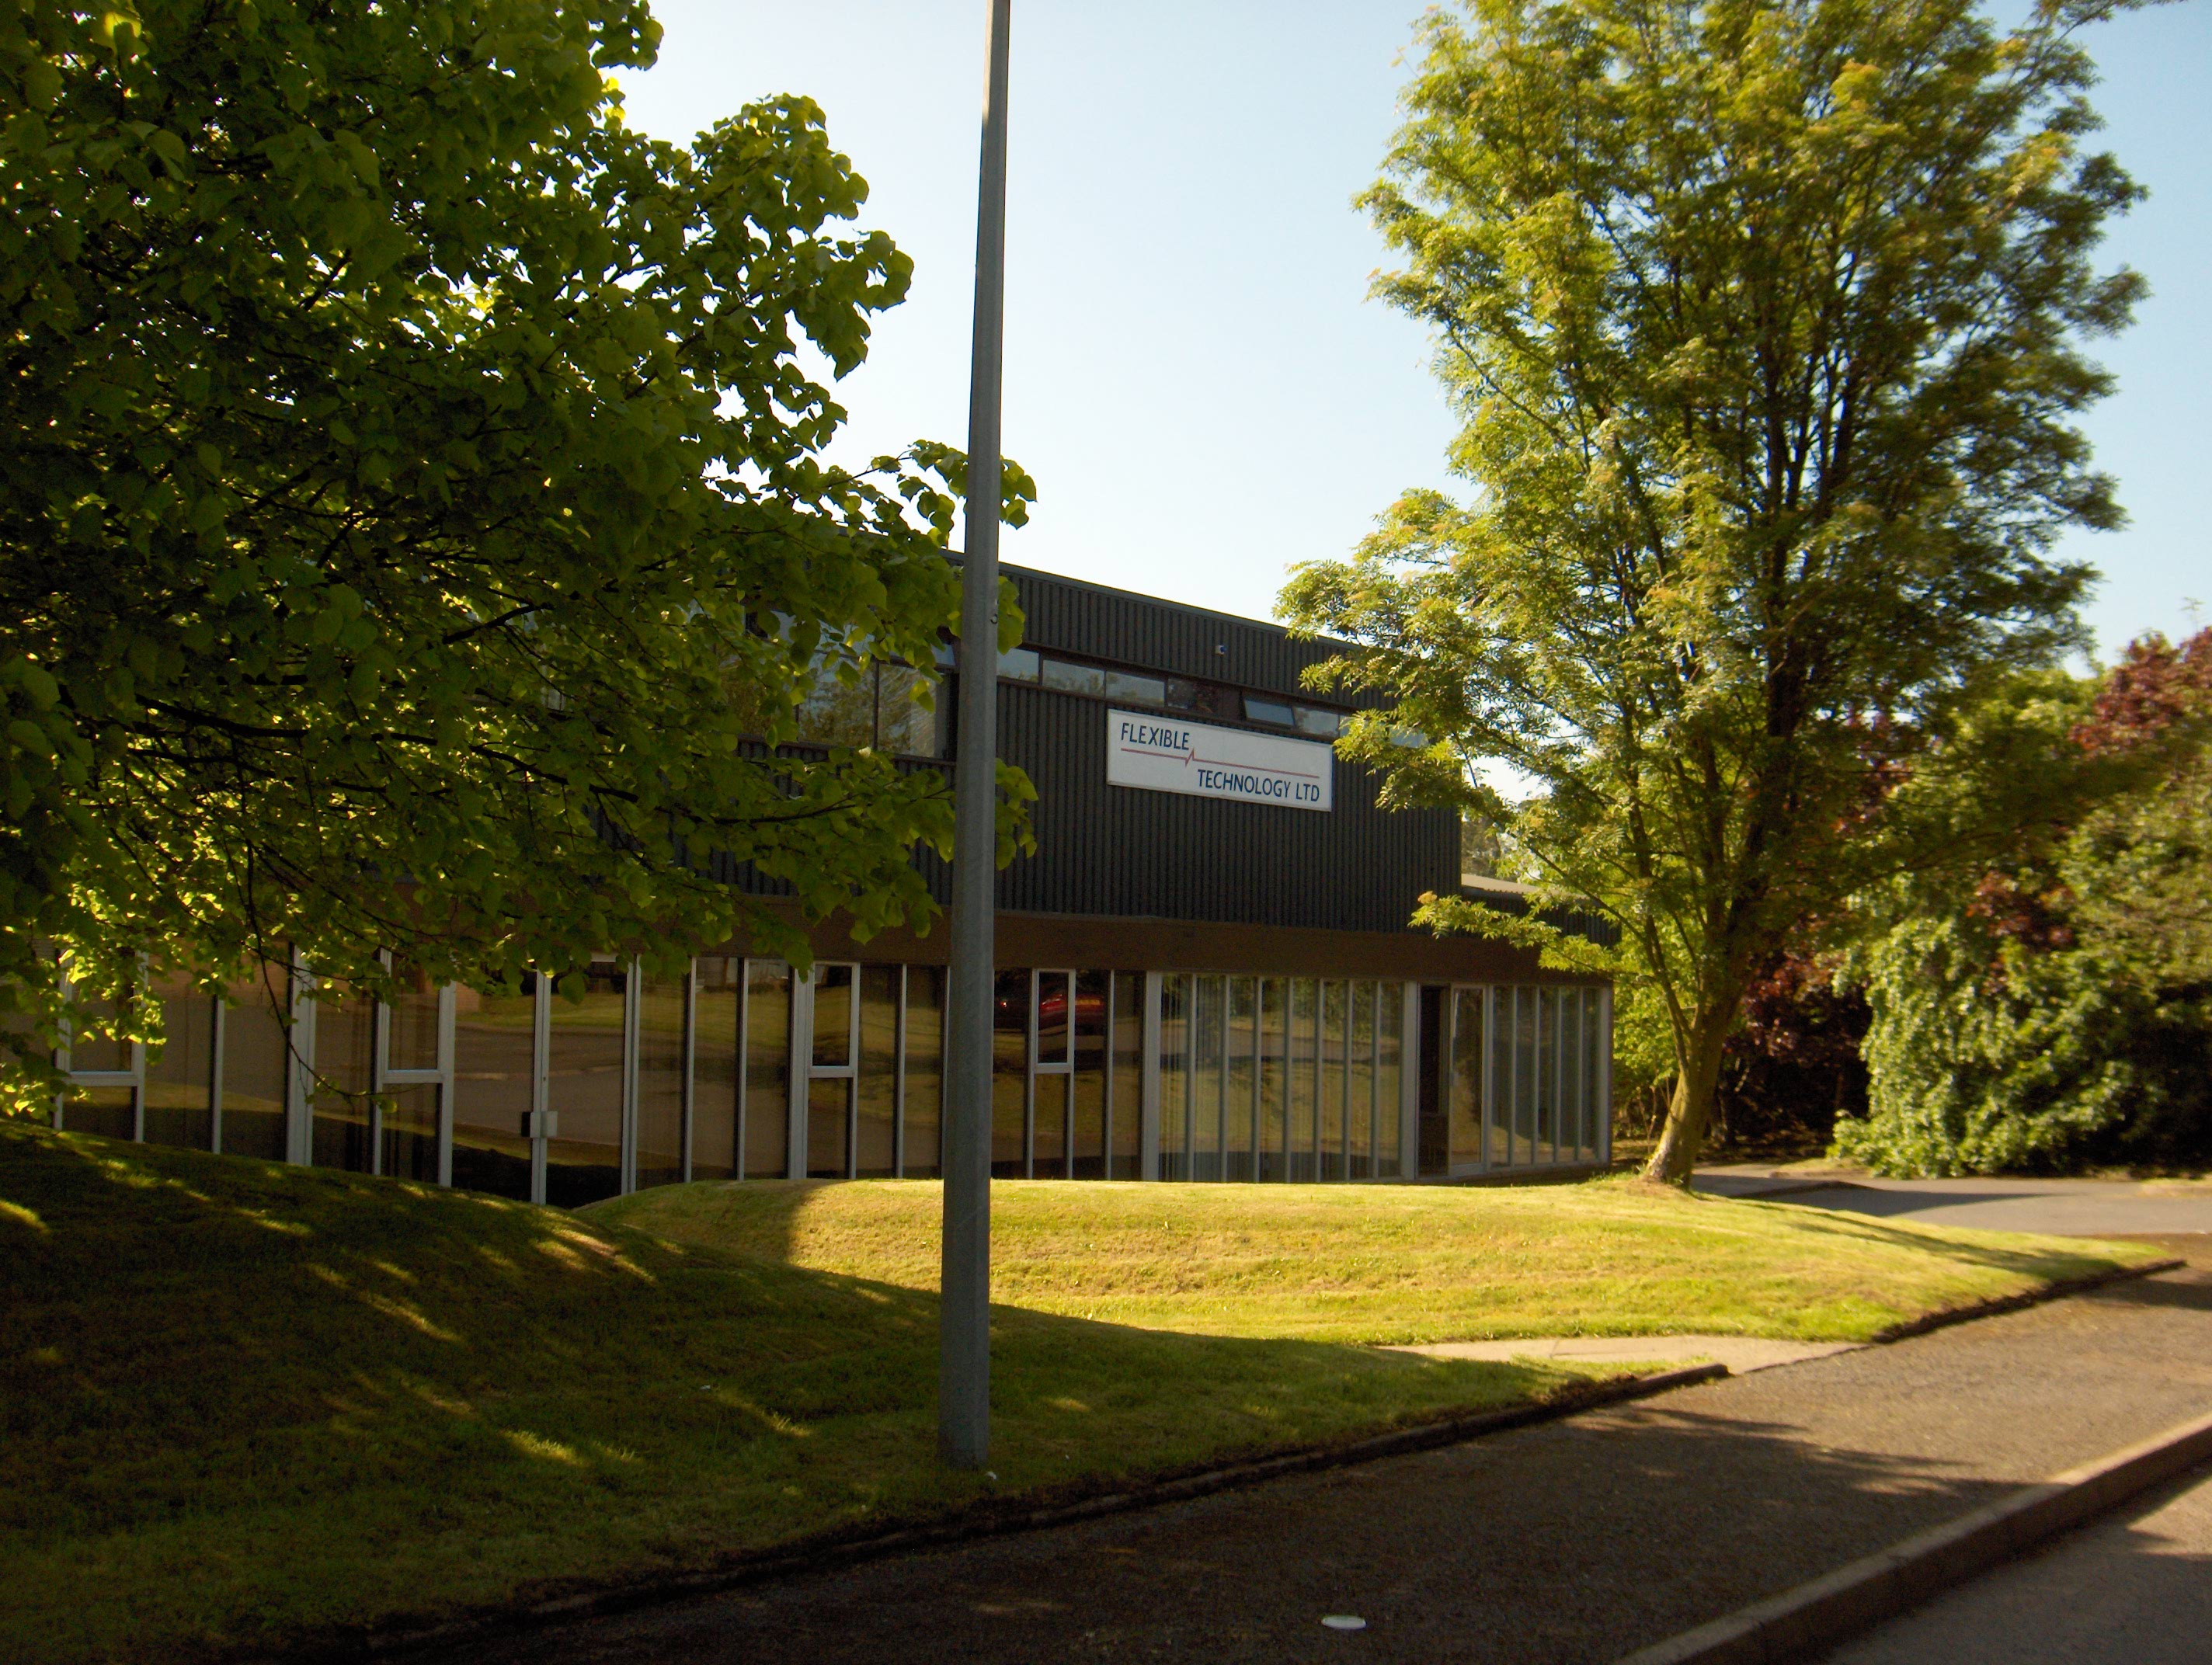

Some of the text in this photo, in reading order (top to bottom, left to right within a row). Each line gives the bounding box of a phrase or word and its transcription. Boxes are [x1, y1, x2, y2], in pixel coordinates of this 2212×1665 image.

[1121, 722, 1190, 751] FLEXIBLE
[1197, 769, 1320, 802] TECHNOLOGY LTD
